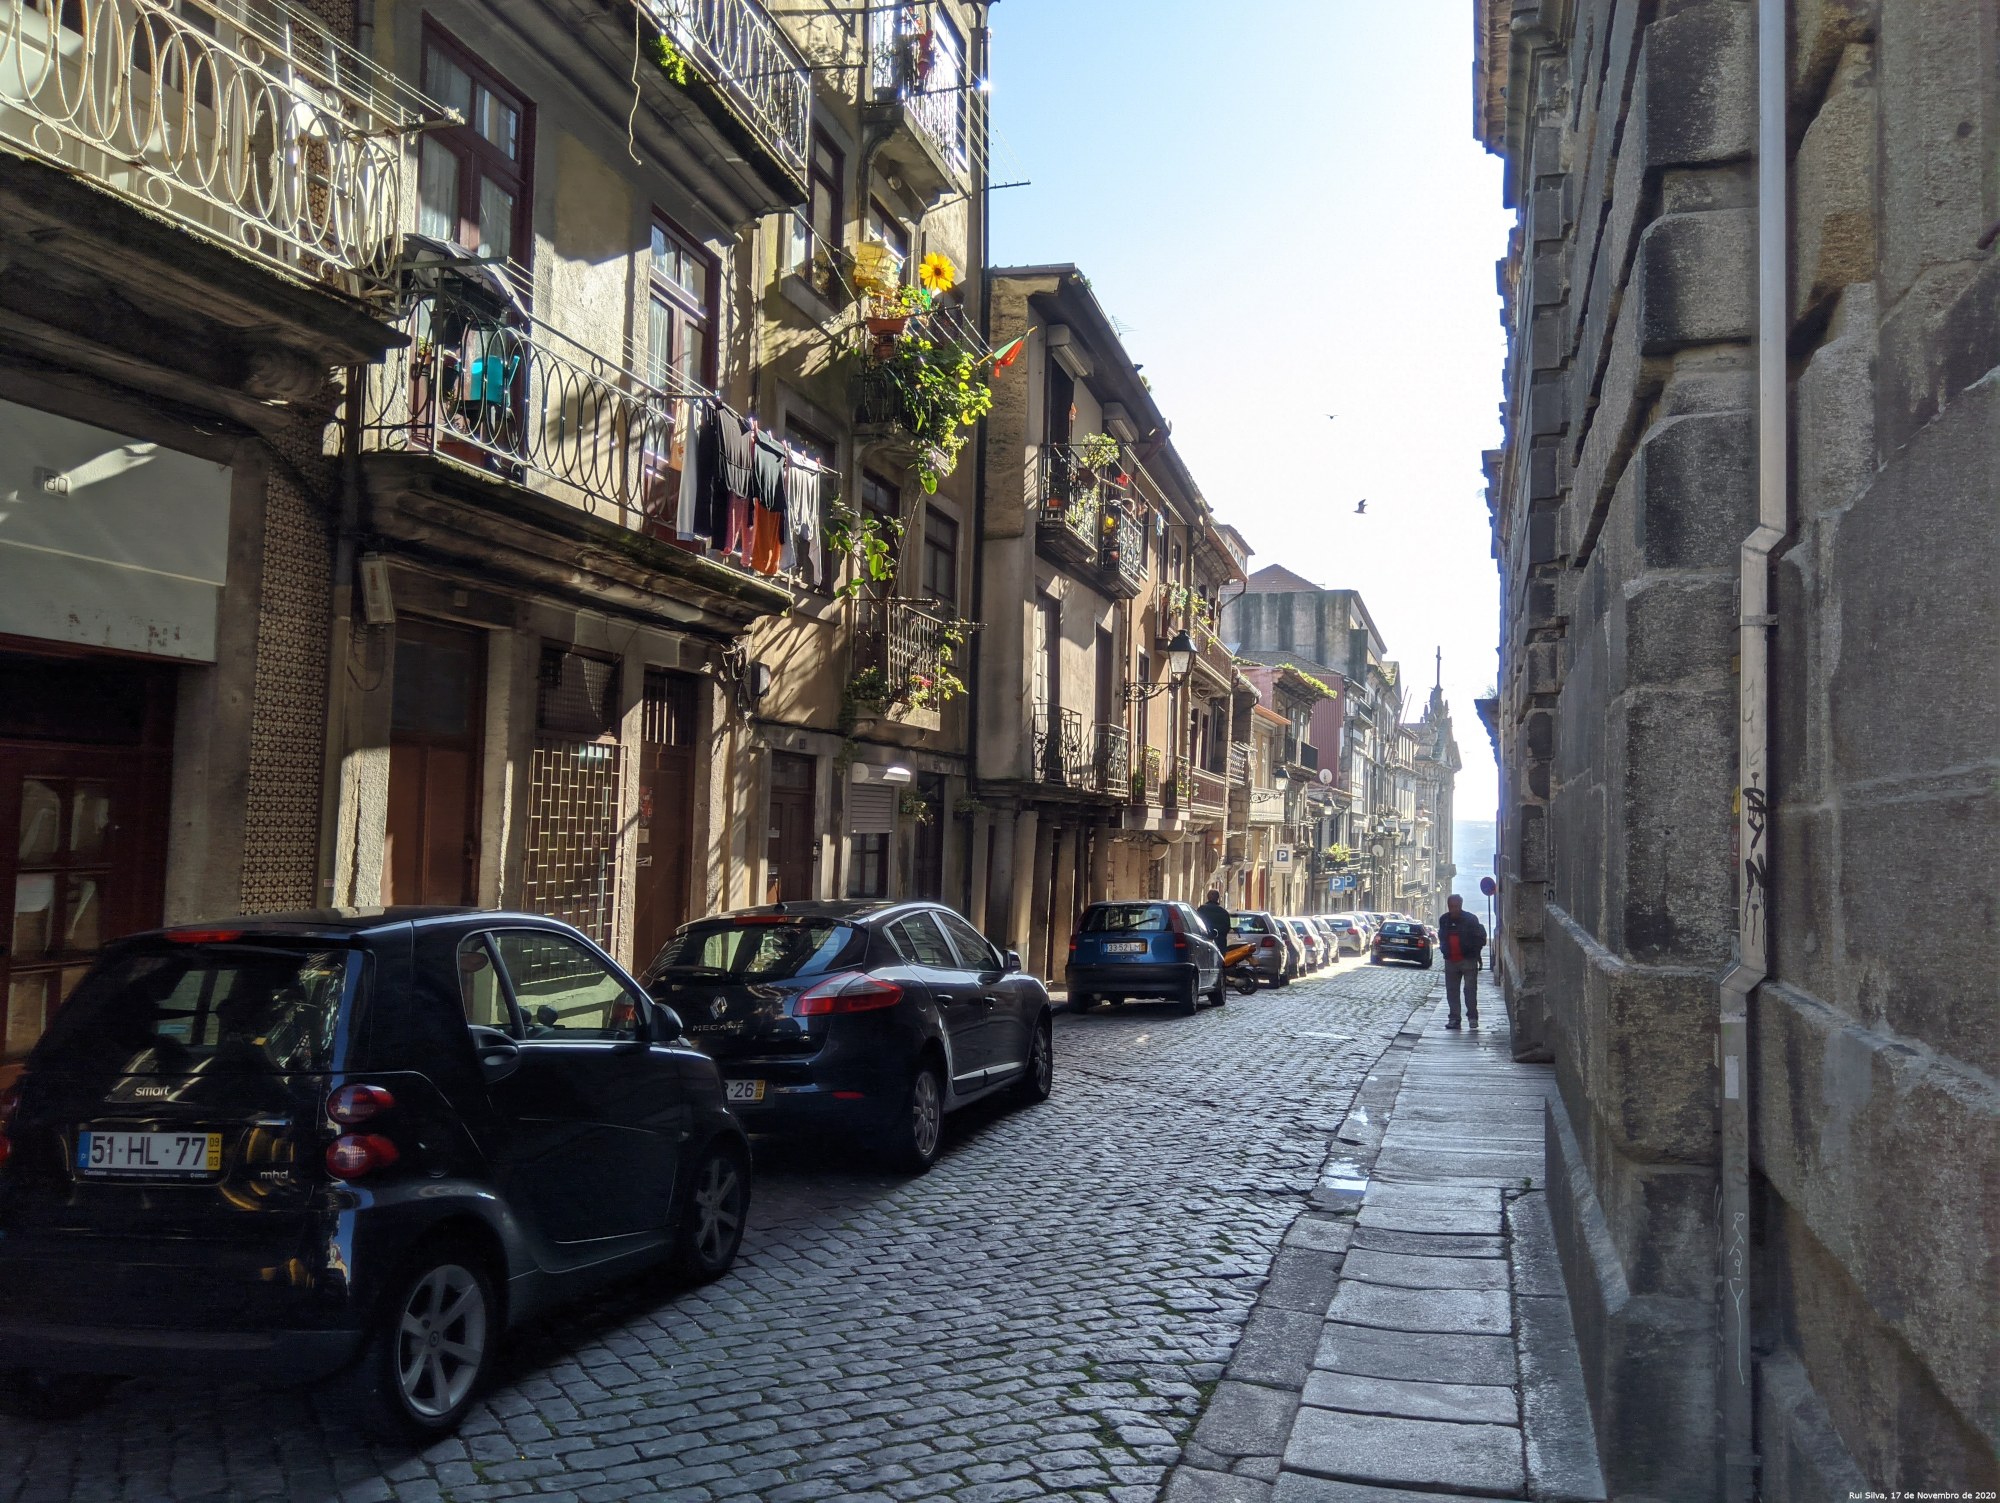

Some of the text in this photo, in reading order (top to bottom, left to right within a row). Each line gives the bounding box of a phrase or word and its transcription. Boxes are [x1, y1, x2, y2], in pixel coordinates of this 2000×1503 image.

[1332, 878, 1341, 890] P
[1345, 875, 1353, 886] P
[135, 1084, 170, 1097] smart
[260, 1169, 289, 1180] mhd
